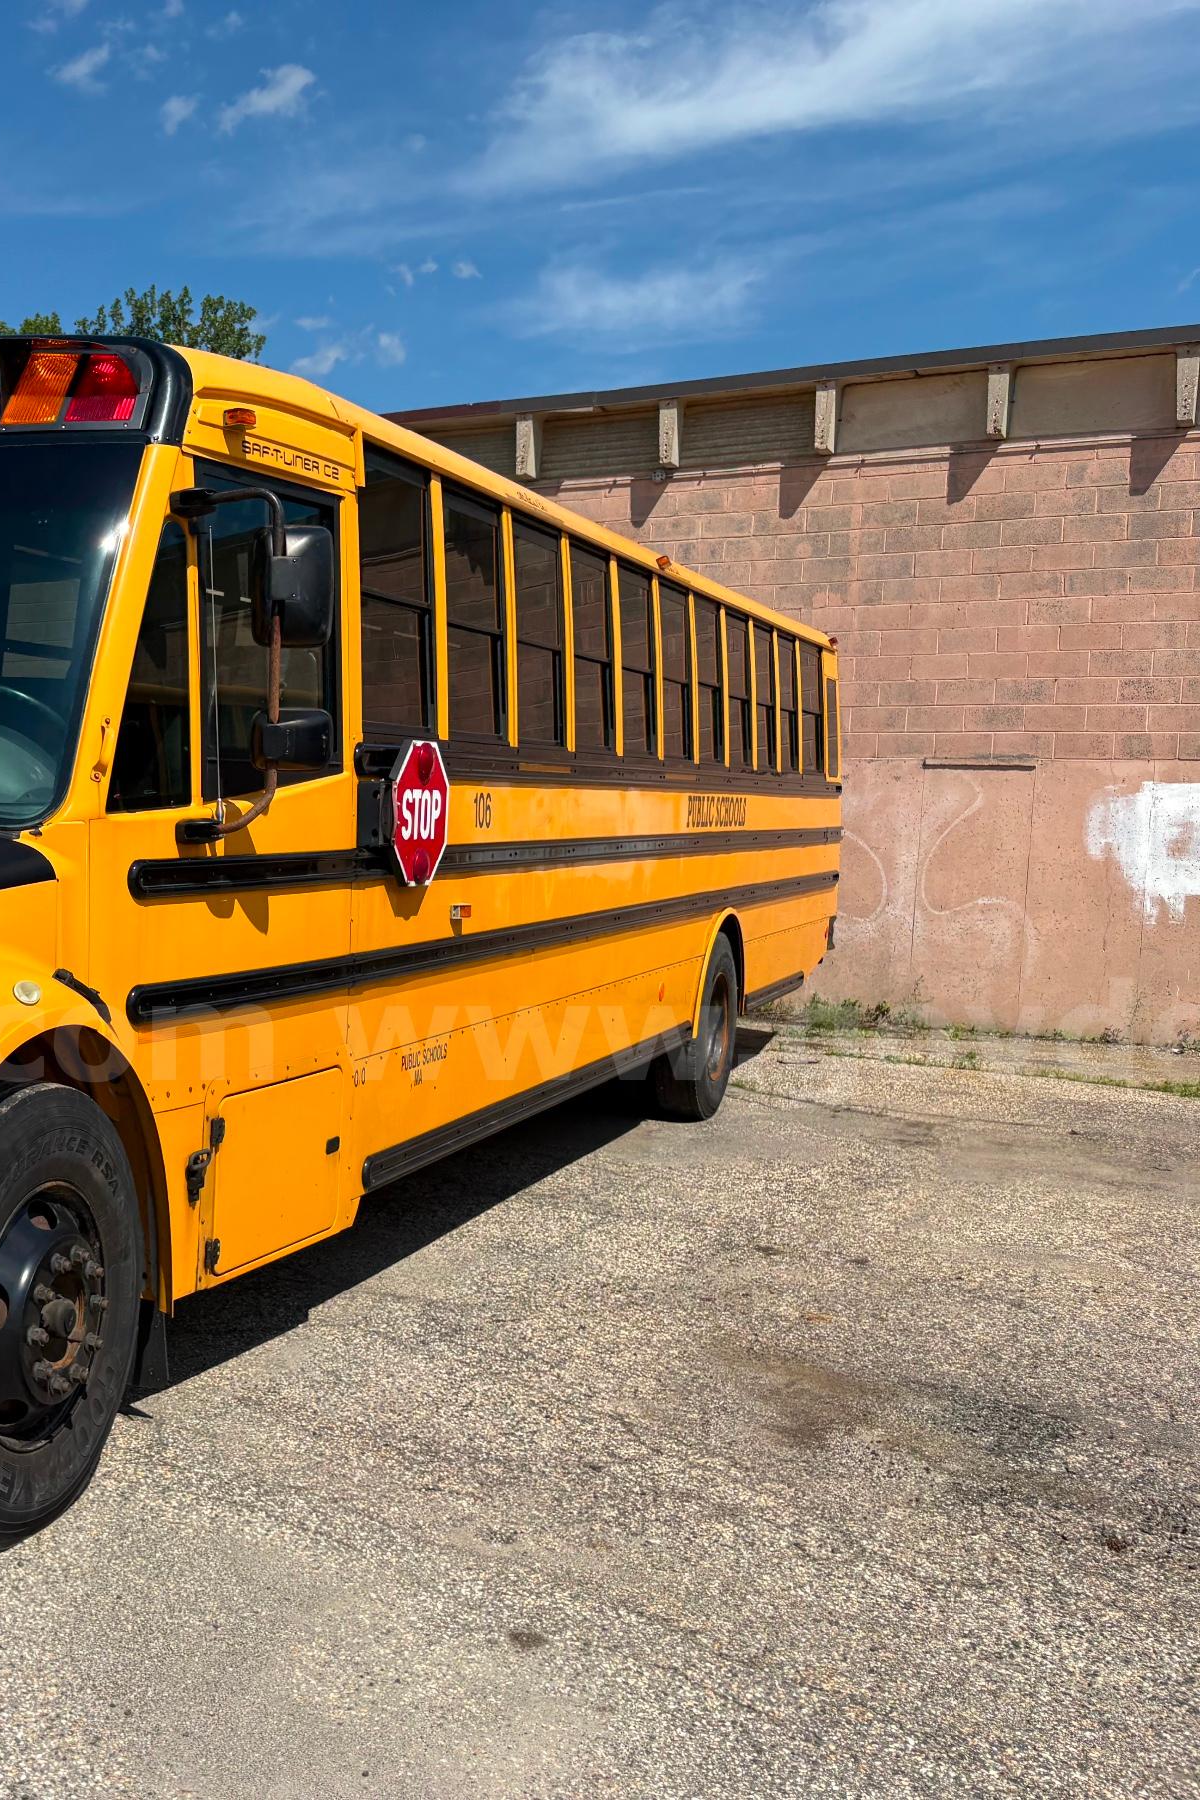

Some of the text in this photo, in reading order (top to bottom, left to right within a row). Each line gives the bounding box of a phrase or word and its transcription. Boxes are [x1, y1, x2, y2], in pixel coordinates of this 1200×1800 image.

[323, 463, 339, 480] C2
[401, 788, 442, 841] STOP
[474, 792, 492, 829] 106
[686, 795, 747, 828] PUBLIC SCHOOLS
[401, 1042, 447, 1071] PUBLIC SCHOOLS
